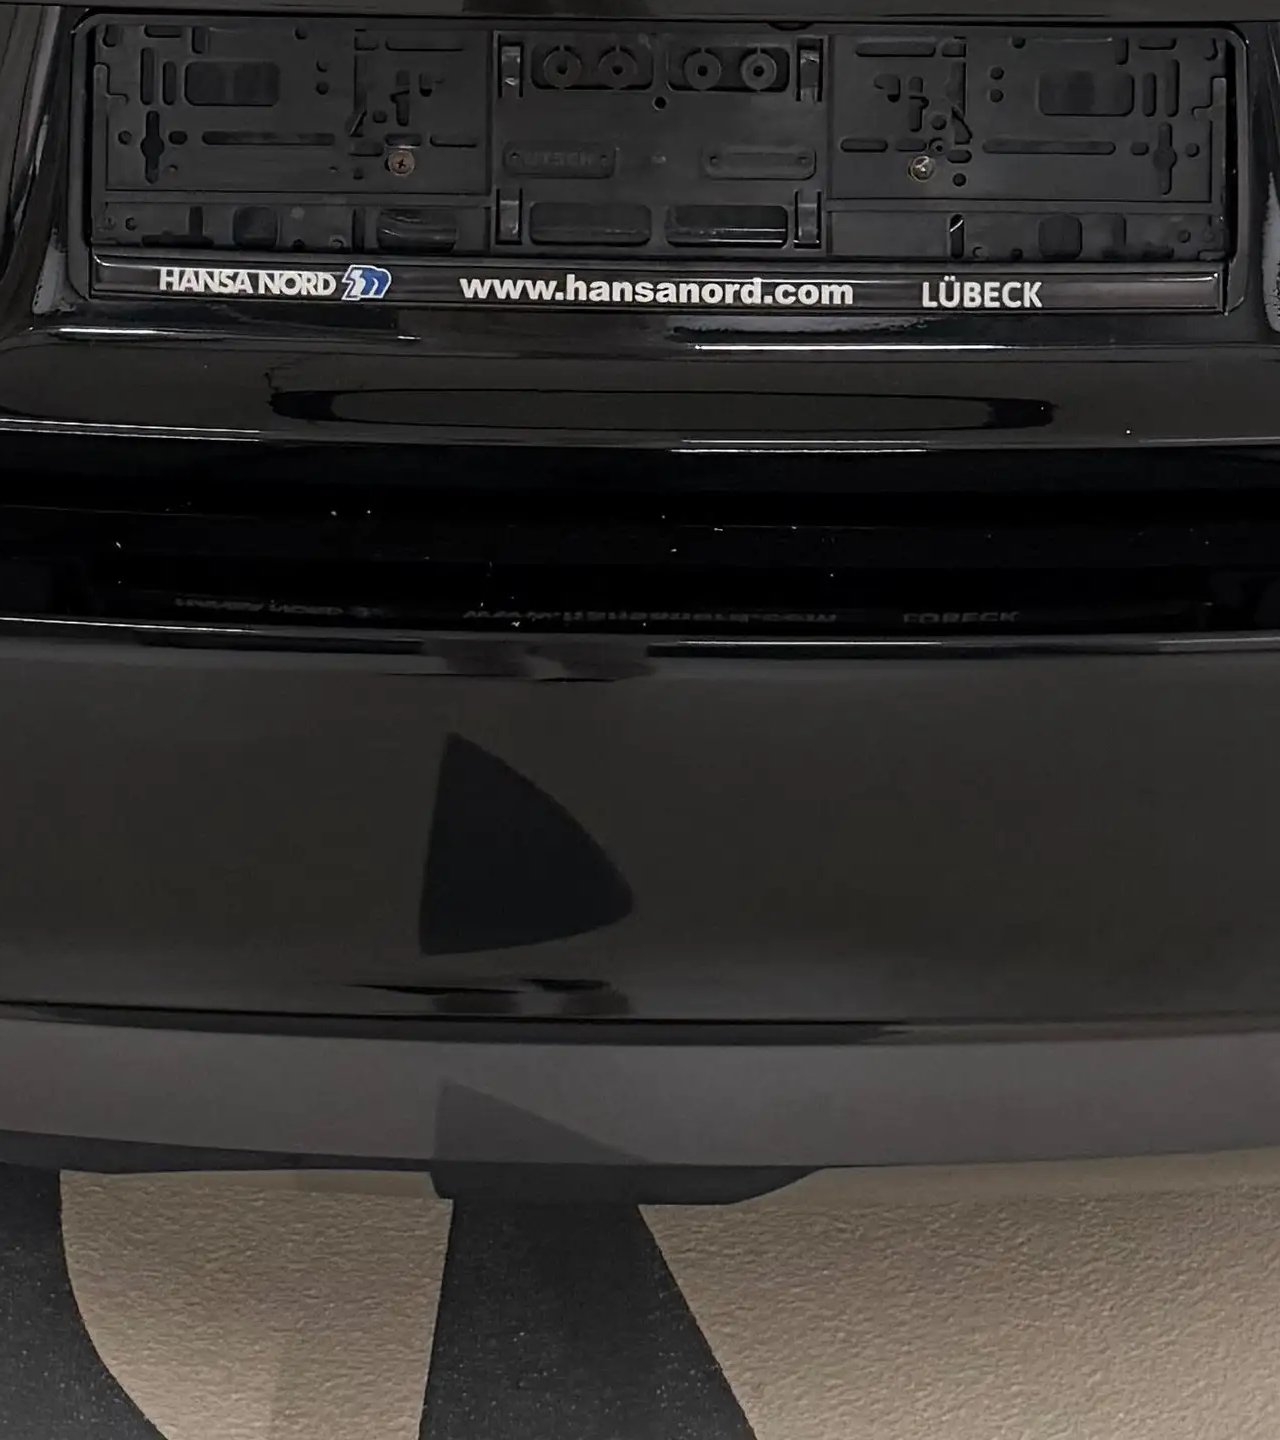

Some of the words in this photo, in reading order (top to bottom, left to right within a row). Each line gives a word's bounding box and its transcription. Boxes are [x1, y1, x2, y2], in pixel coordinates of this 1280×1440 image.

[159, 267, 254, 295] HANSA
[257, 271, 337, 296] NORD
[459, 274, 854, 305] www.hansanord.com
[922, 275, 1043, 308] LÜBECK
